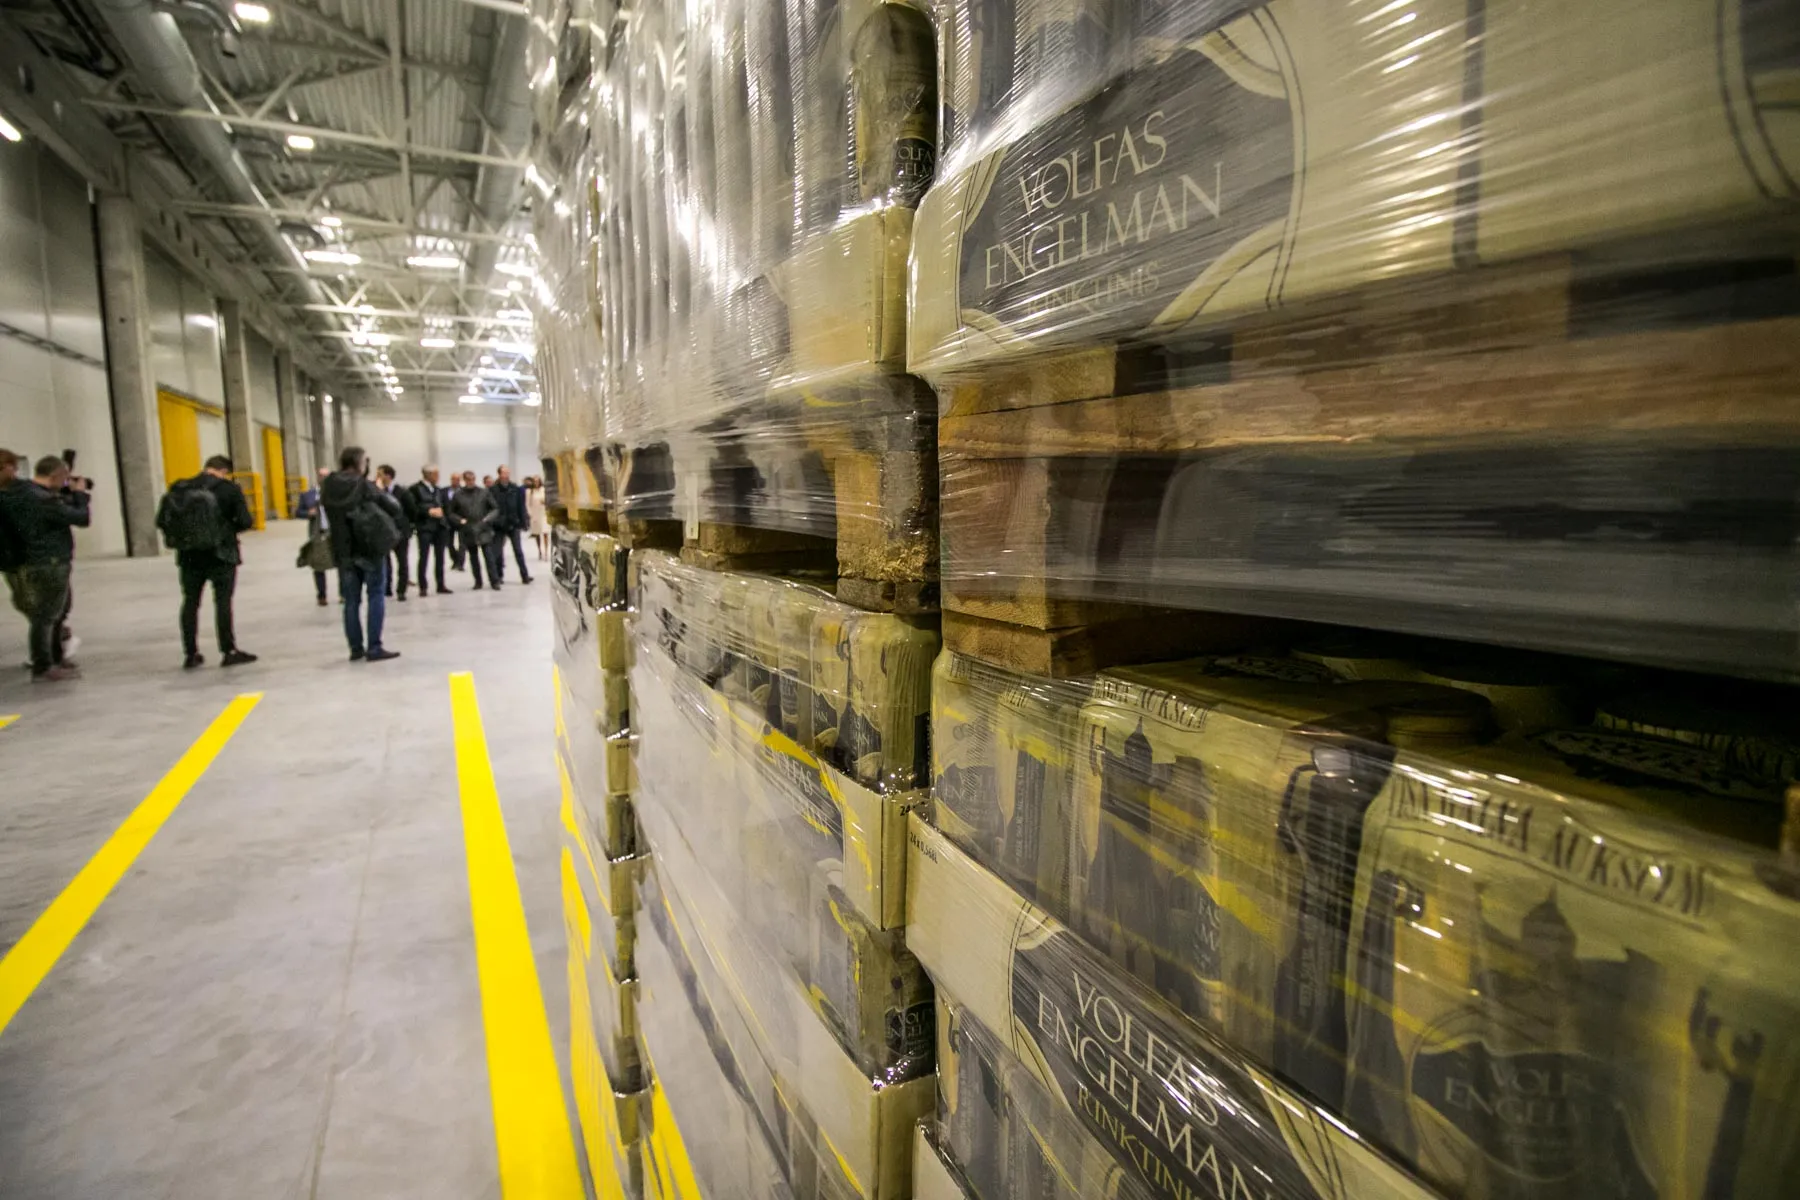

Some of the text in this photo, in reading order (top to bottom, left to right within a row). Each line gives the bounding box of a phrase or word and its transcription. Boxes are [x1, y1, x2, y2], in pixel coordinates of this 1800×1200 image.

[985, 161, 1223, 290] ENGELMAN
[1019, 111, 1167, 218] VOLFAS
[1038, 991, 1274, 1199] ENGELMAN
[1073, 970, 1219, 1126] VOLFAS
[1078, 1086, 1200, 1199] RINKTINI
